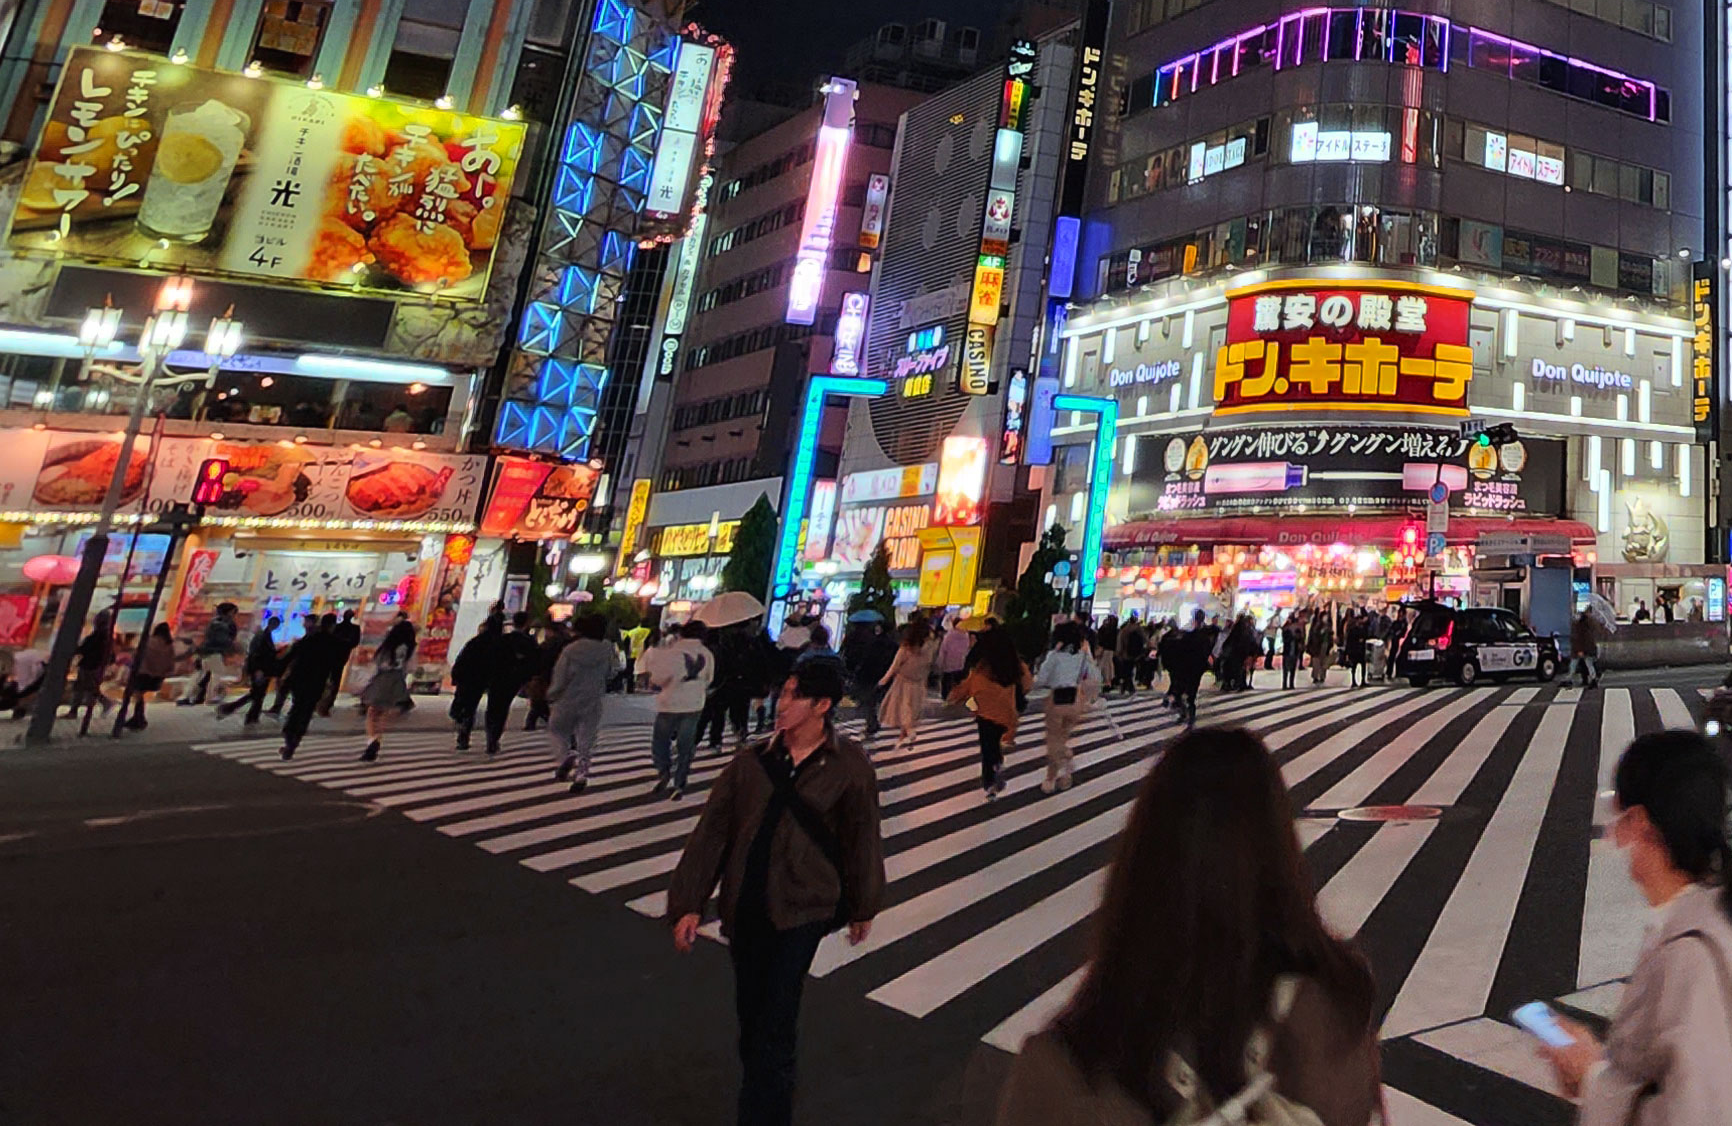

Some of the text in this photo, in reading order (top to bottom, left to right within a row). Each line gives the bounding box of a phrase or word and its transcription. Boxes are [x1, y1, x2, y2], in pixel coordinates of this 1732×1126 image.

[53, 67, 113, 238] レモンサワー
[269, 178, 302, 209] 光
[248, 246, 284, 269] 4F
[1253, 294, 1428, 333] 驚安の殿堂
[968, 328, 986, 390] CASINO
[1110, 359, 1181, 388] Don Quijote
[1531, 357, 1633, 390] Don Quijote
